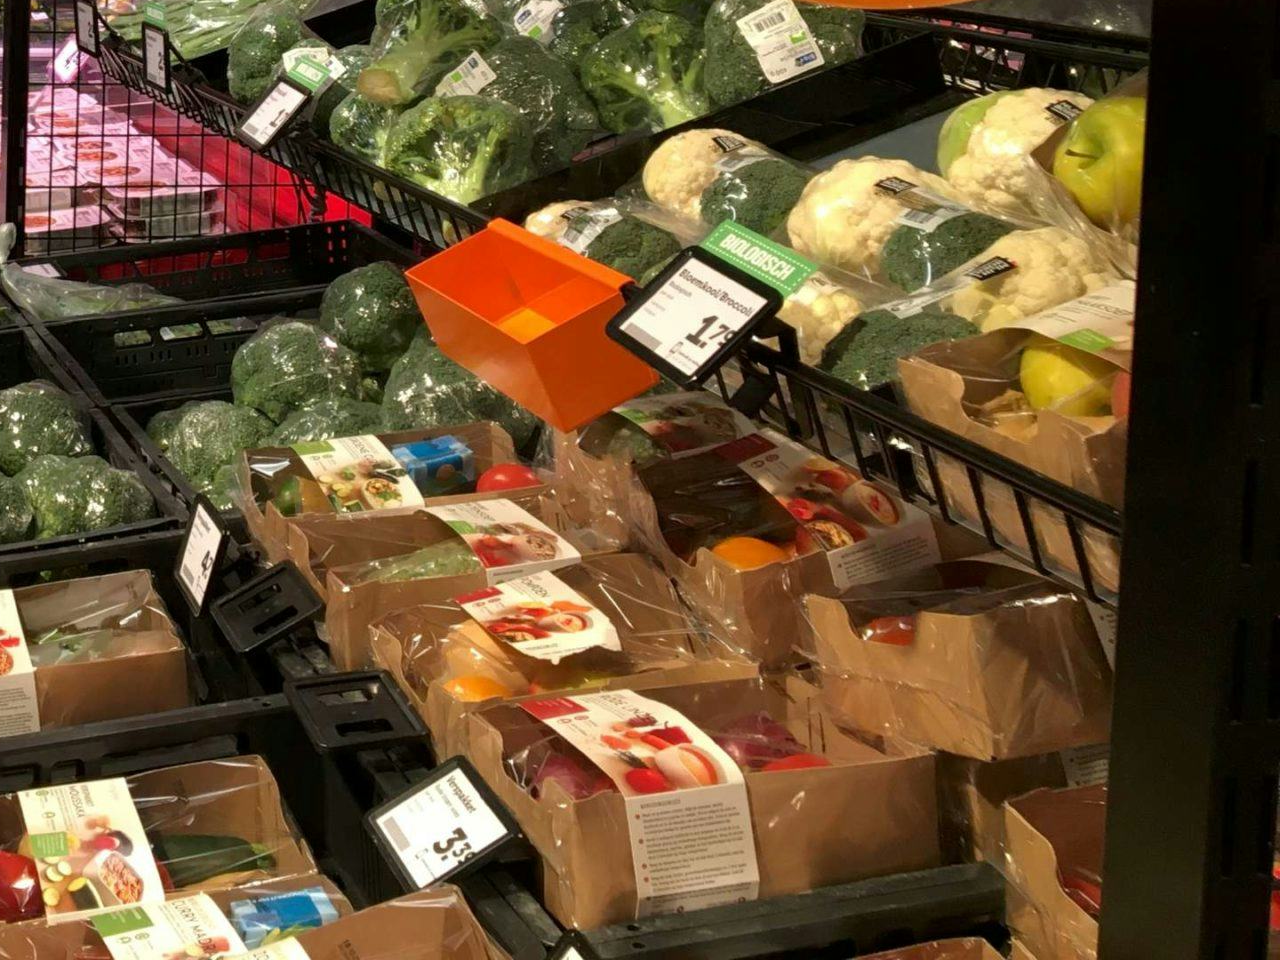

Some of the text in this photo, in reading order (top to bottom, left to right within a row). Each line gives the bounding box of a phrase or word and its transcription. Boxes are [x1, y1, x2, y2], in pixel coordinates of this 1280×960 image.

[720, 233, 796, 281] BIOLOGISCH
[679, 268, 754, 318] Bloemkool/Broccoli
[68, 785, 86, 818] MOUSSAKA
[446, 775, 477, 814] Verspakket
[172, 900, 200, 923] CURRY
